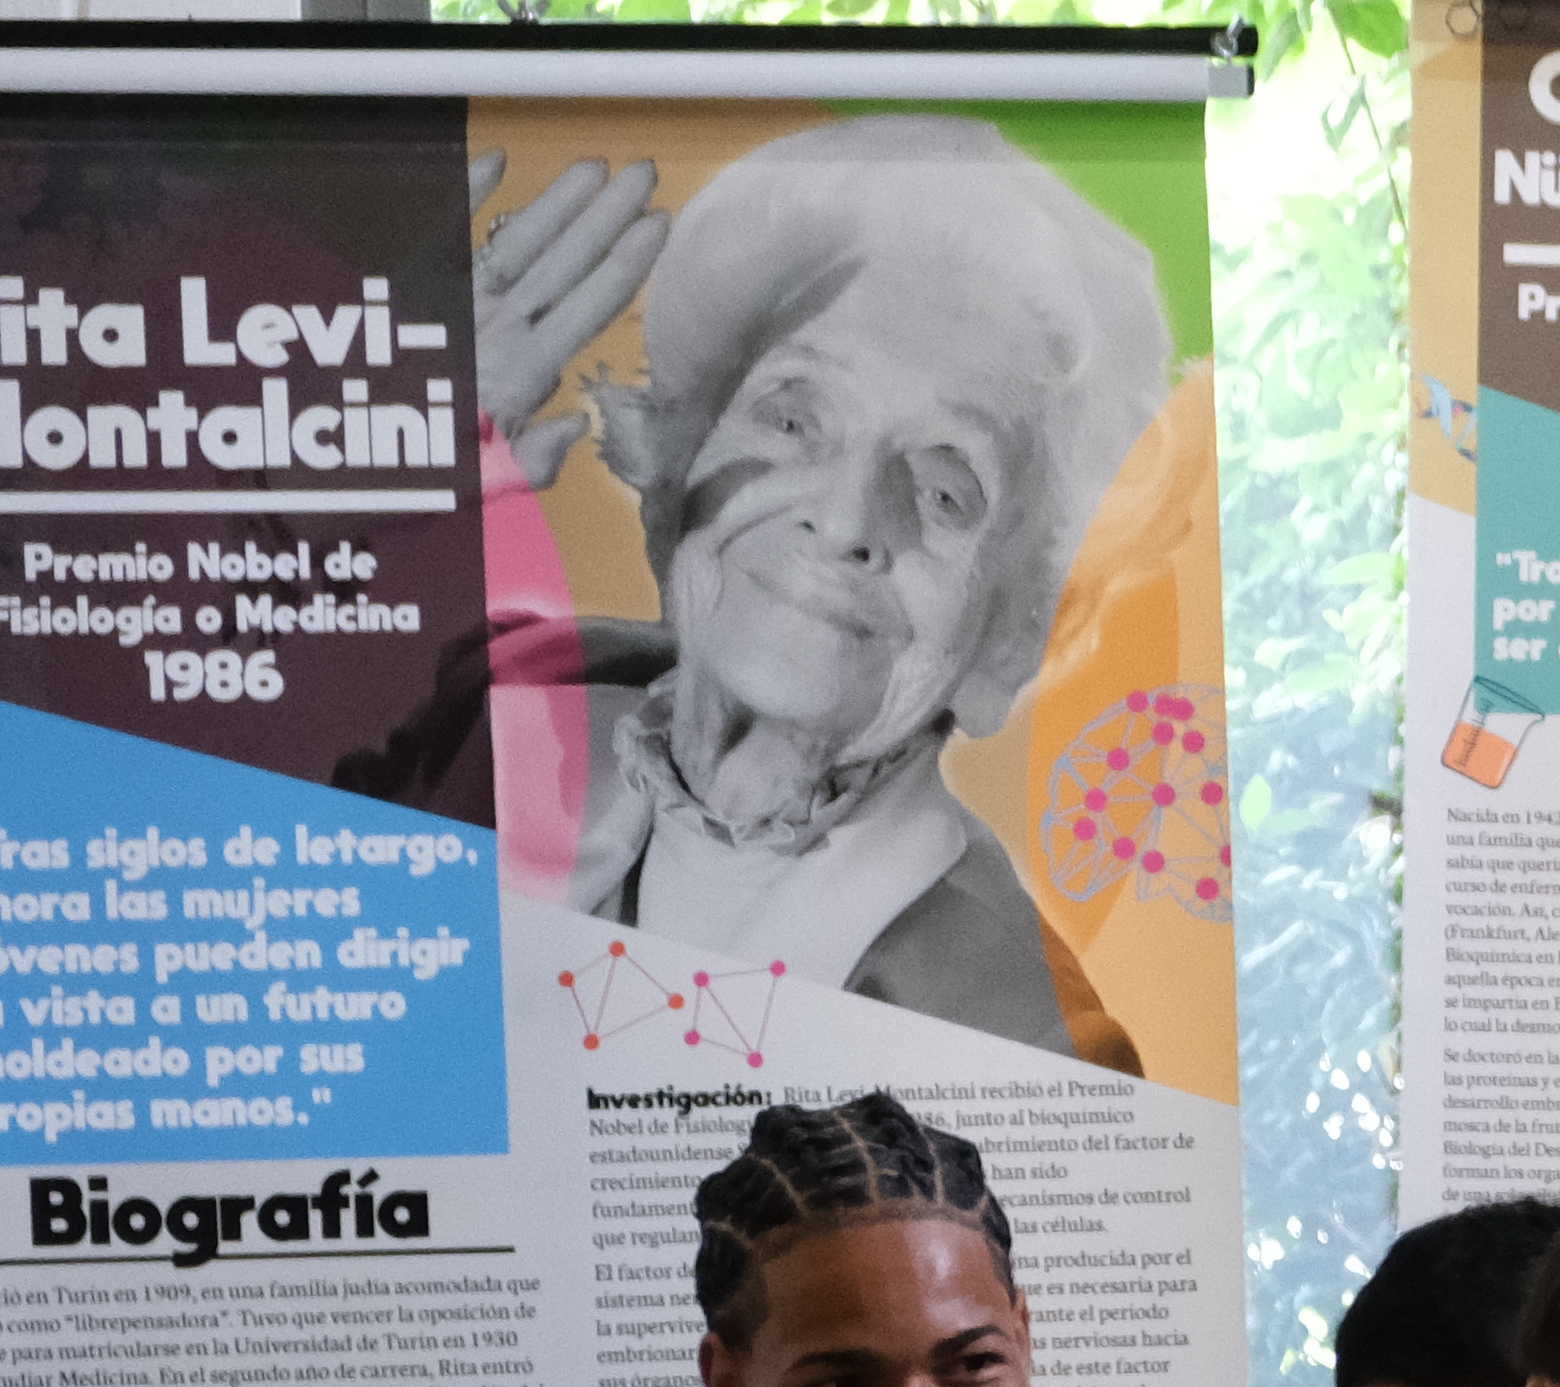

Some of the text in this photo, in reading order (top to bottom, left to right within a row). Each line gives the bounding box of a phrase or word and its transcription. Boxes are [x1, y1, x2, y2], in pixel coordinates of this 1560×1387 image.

[0, 276, 447, 368] ita Levi-
[23, 541, 378, 582] Premio Nobel de
[0, 593, 420, 646] isiología o Medicina
[1493, 597, 1556, 633] por
[1493, 636, 1547, 661] ser
[144, 649, 284, 702] 1986
[86, 824, 478, 882] siglos de letargo,
[105, 877, 361, 930] las mujeres
[154, 926, 470, 985] pueden dirigir
[20, 981, 407, 1027] vista a un futuro
[205, 1042, 365, 1087] por sus
[150, 1082, 332, 1128] manos."
[587, 1085, 773, 1117] Investigación:
[30, 1169, 431, 1267] Biografía
